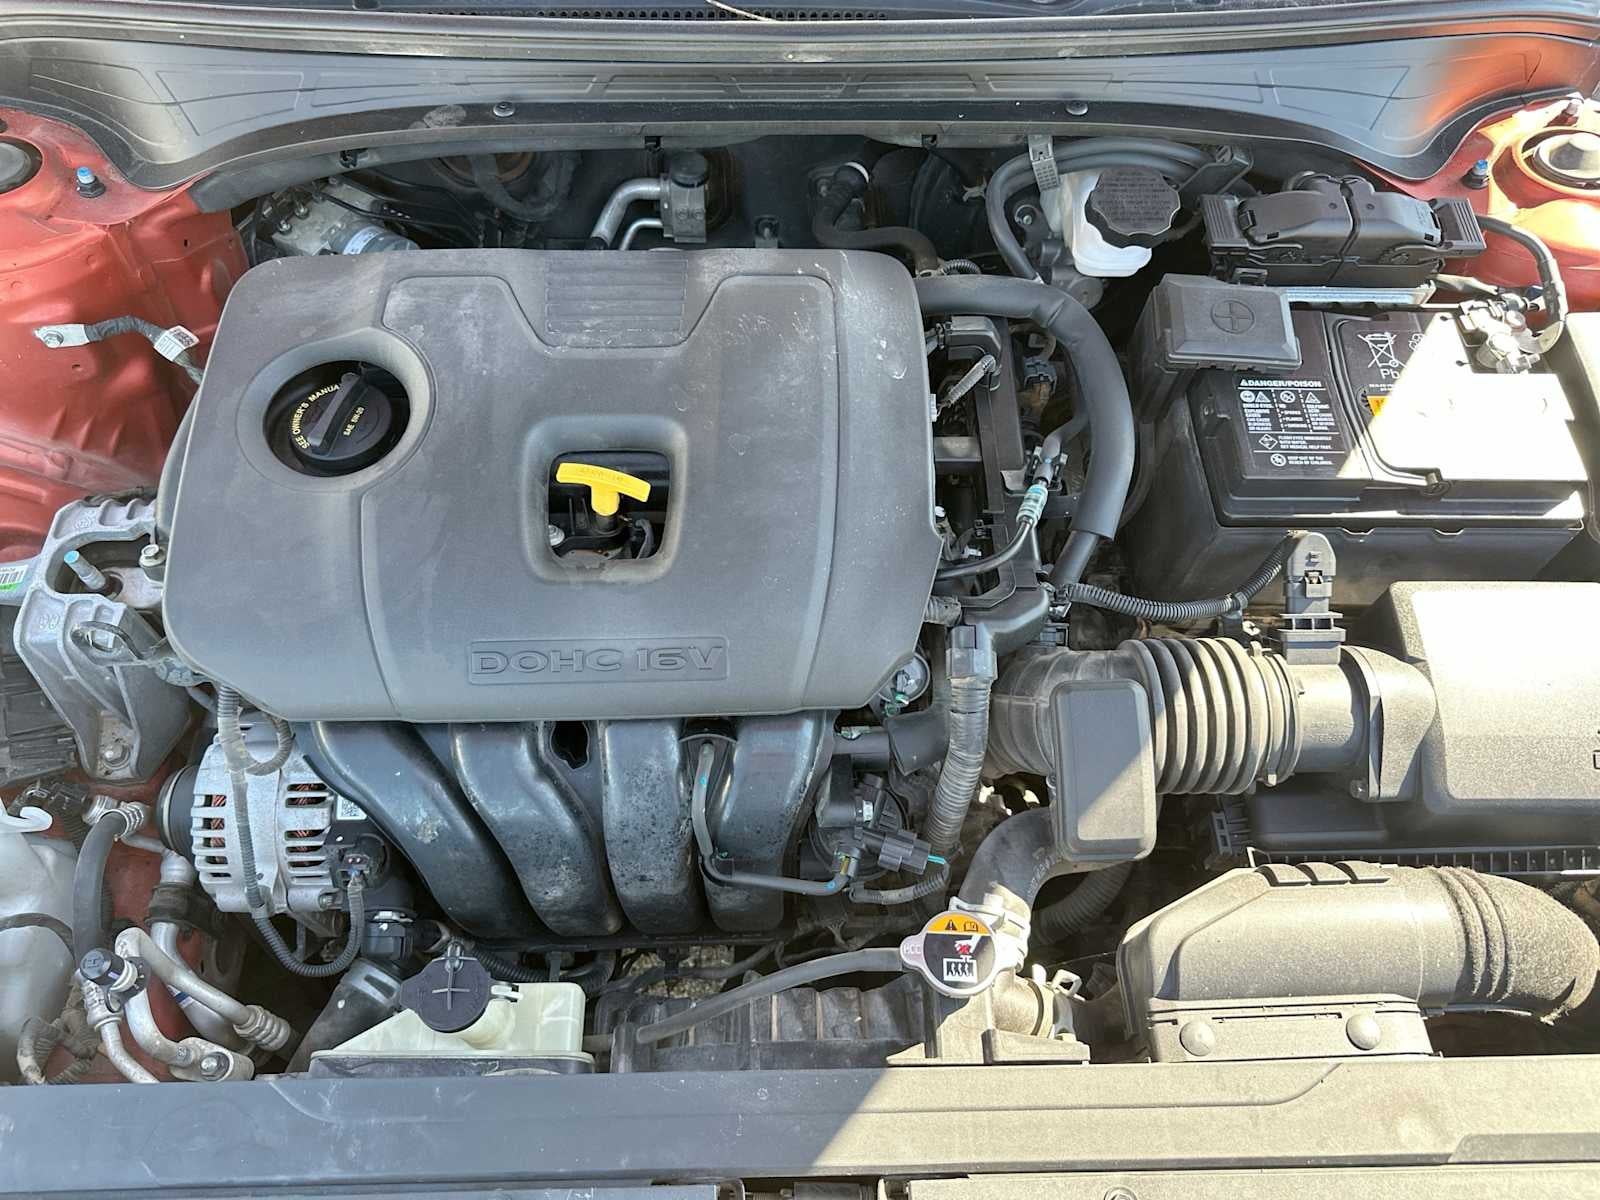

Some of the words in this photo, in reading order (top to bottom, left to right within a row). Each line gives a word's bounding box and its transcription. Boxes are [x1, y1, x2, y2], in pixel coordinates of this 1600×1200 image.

[1380, 368, 1400, 379] Pb
[308, 383, 343, 402] MANUA
[292, 402, 310, 435] OWNER'S
[295, 434, 311, 449] SEE
[471, 648, 624, 675] DOHC
[636, 646, 723, 673] 16V
